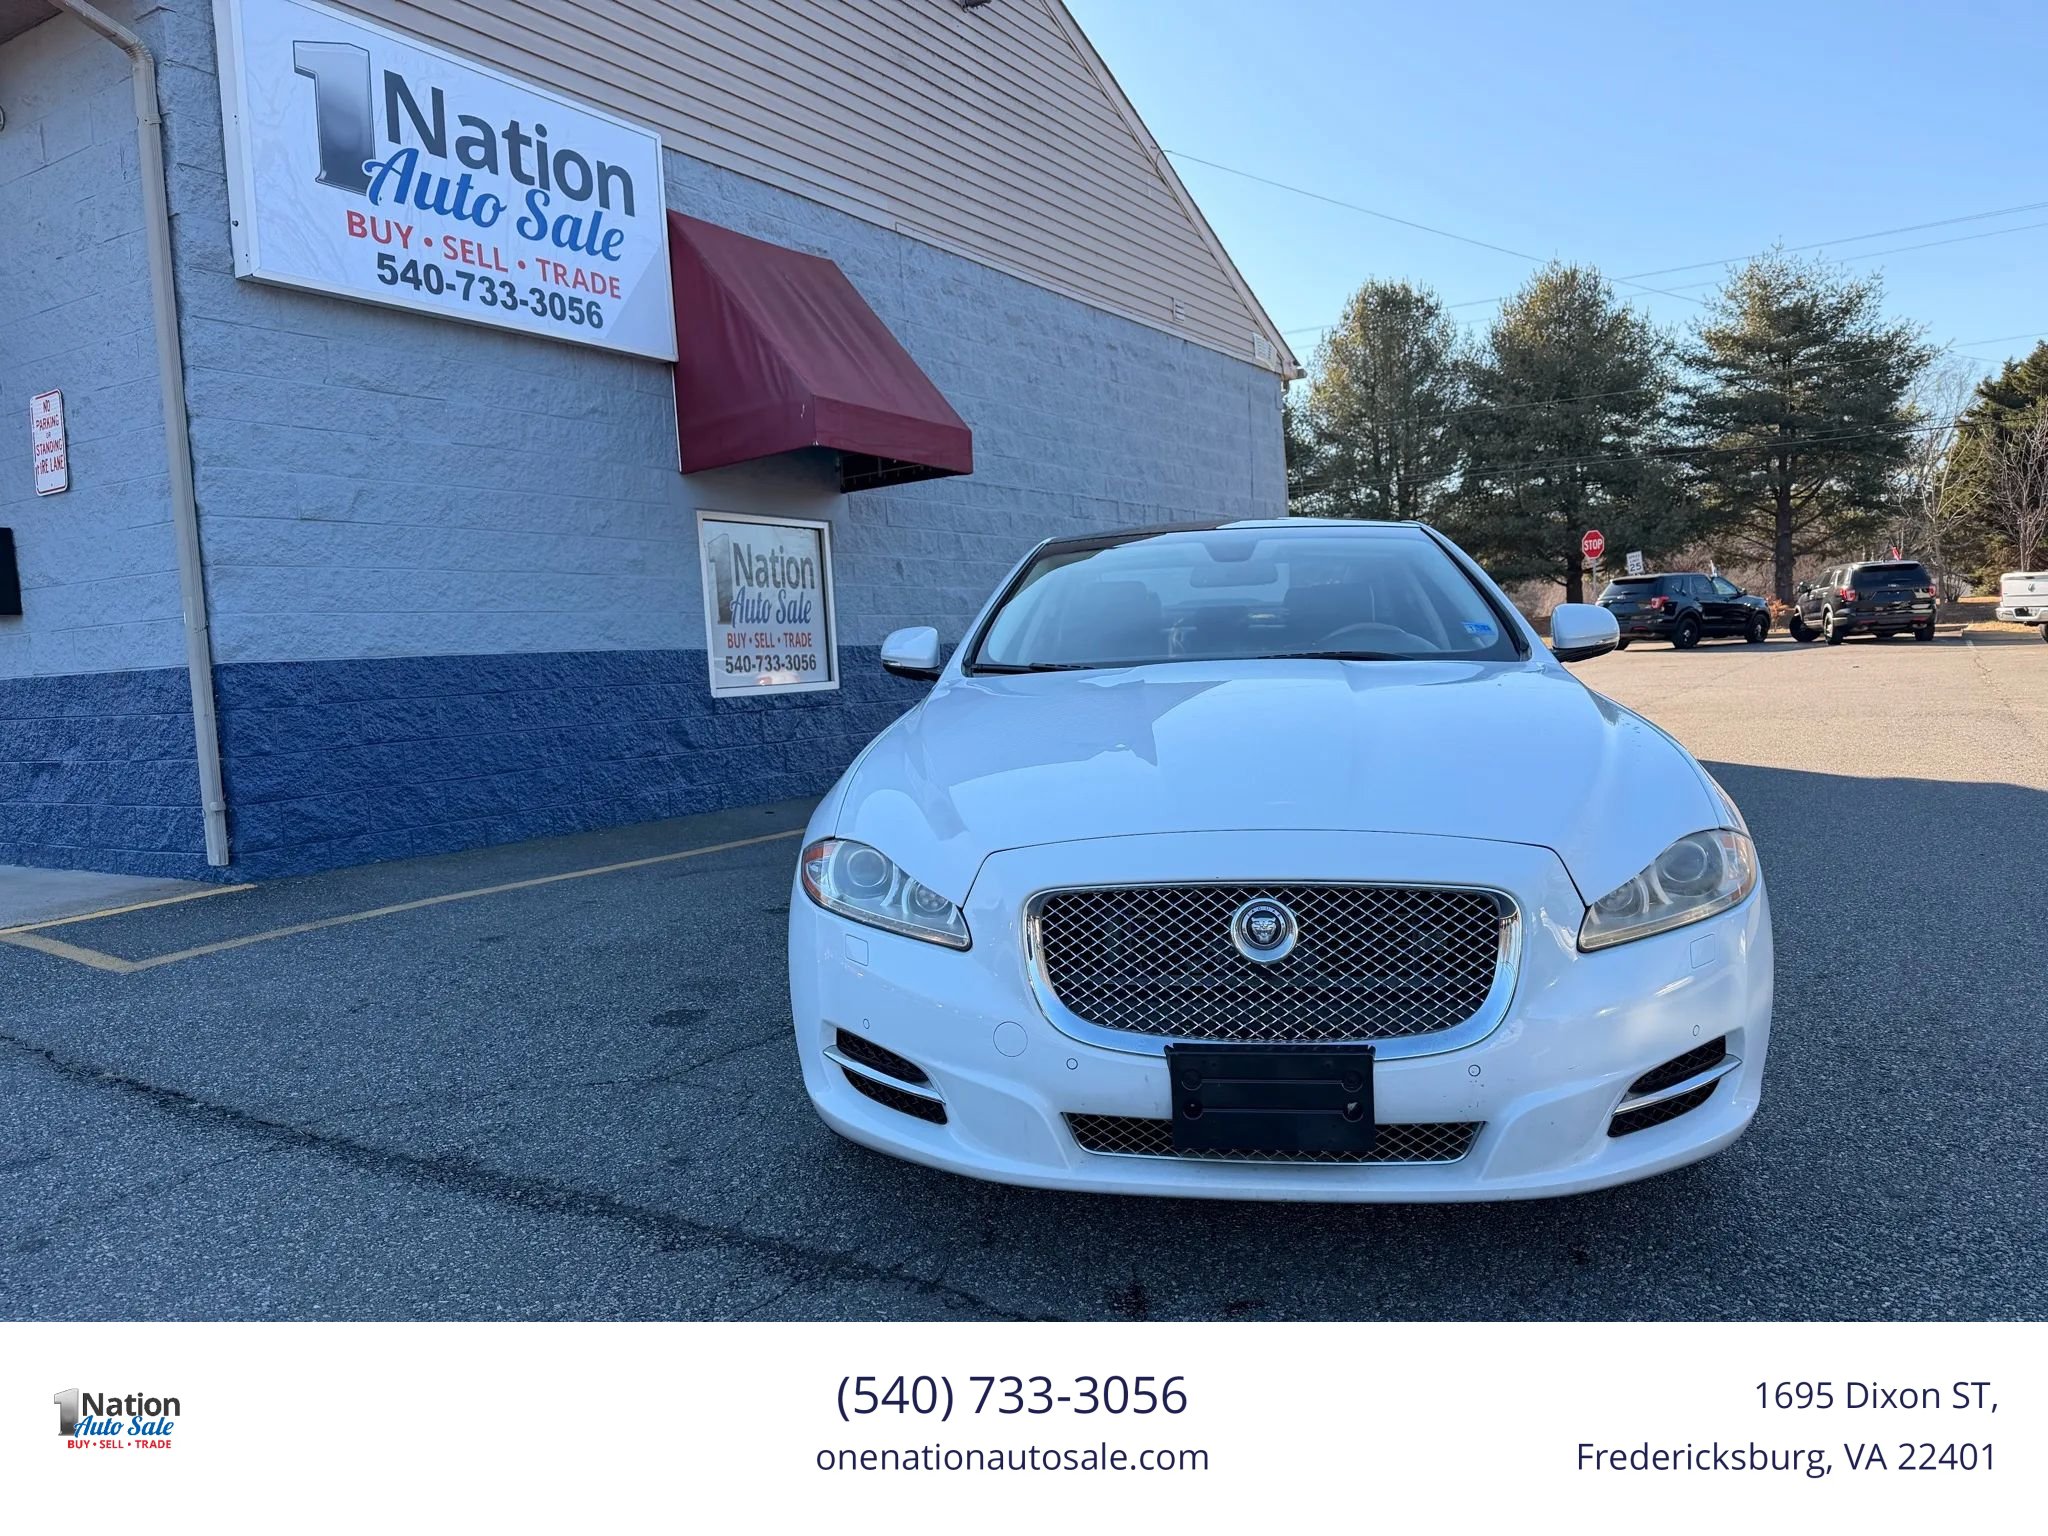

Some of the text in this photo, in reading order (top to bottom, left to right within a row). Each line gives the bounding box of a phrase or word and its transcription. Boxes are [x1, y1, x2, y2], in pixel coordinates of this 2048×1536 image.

[293, 40, 635, 217] 1 Nation
[364, 147, 625, 261] Auto Sale
[347, 210, 621, 300] BUY SELL TRADE
[377, 252, 603, 329] 540-733-3056
[43, 400, 50, 413] NO
[36, 414, 59, 431] PARKING
[36, 439, 62, 456] STANDING
[50, 455, 64, 472] LANE
[1584, 539, 1602, 551] STOP
[732, 542, 815, 589] Nation
[1629, 562, 1642, 571] 25
[730, 586, 812, 628] Auto Sale
[727, 632, 812, 649] BUY SELL TRADE
[725, 654, 817, 673] 540-733-3056
